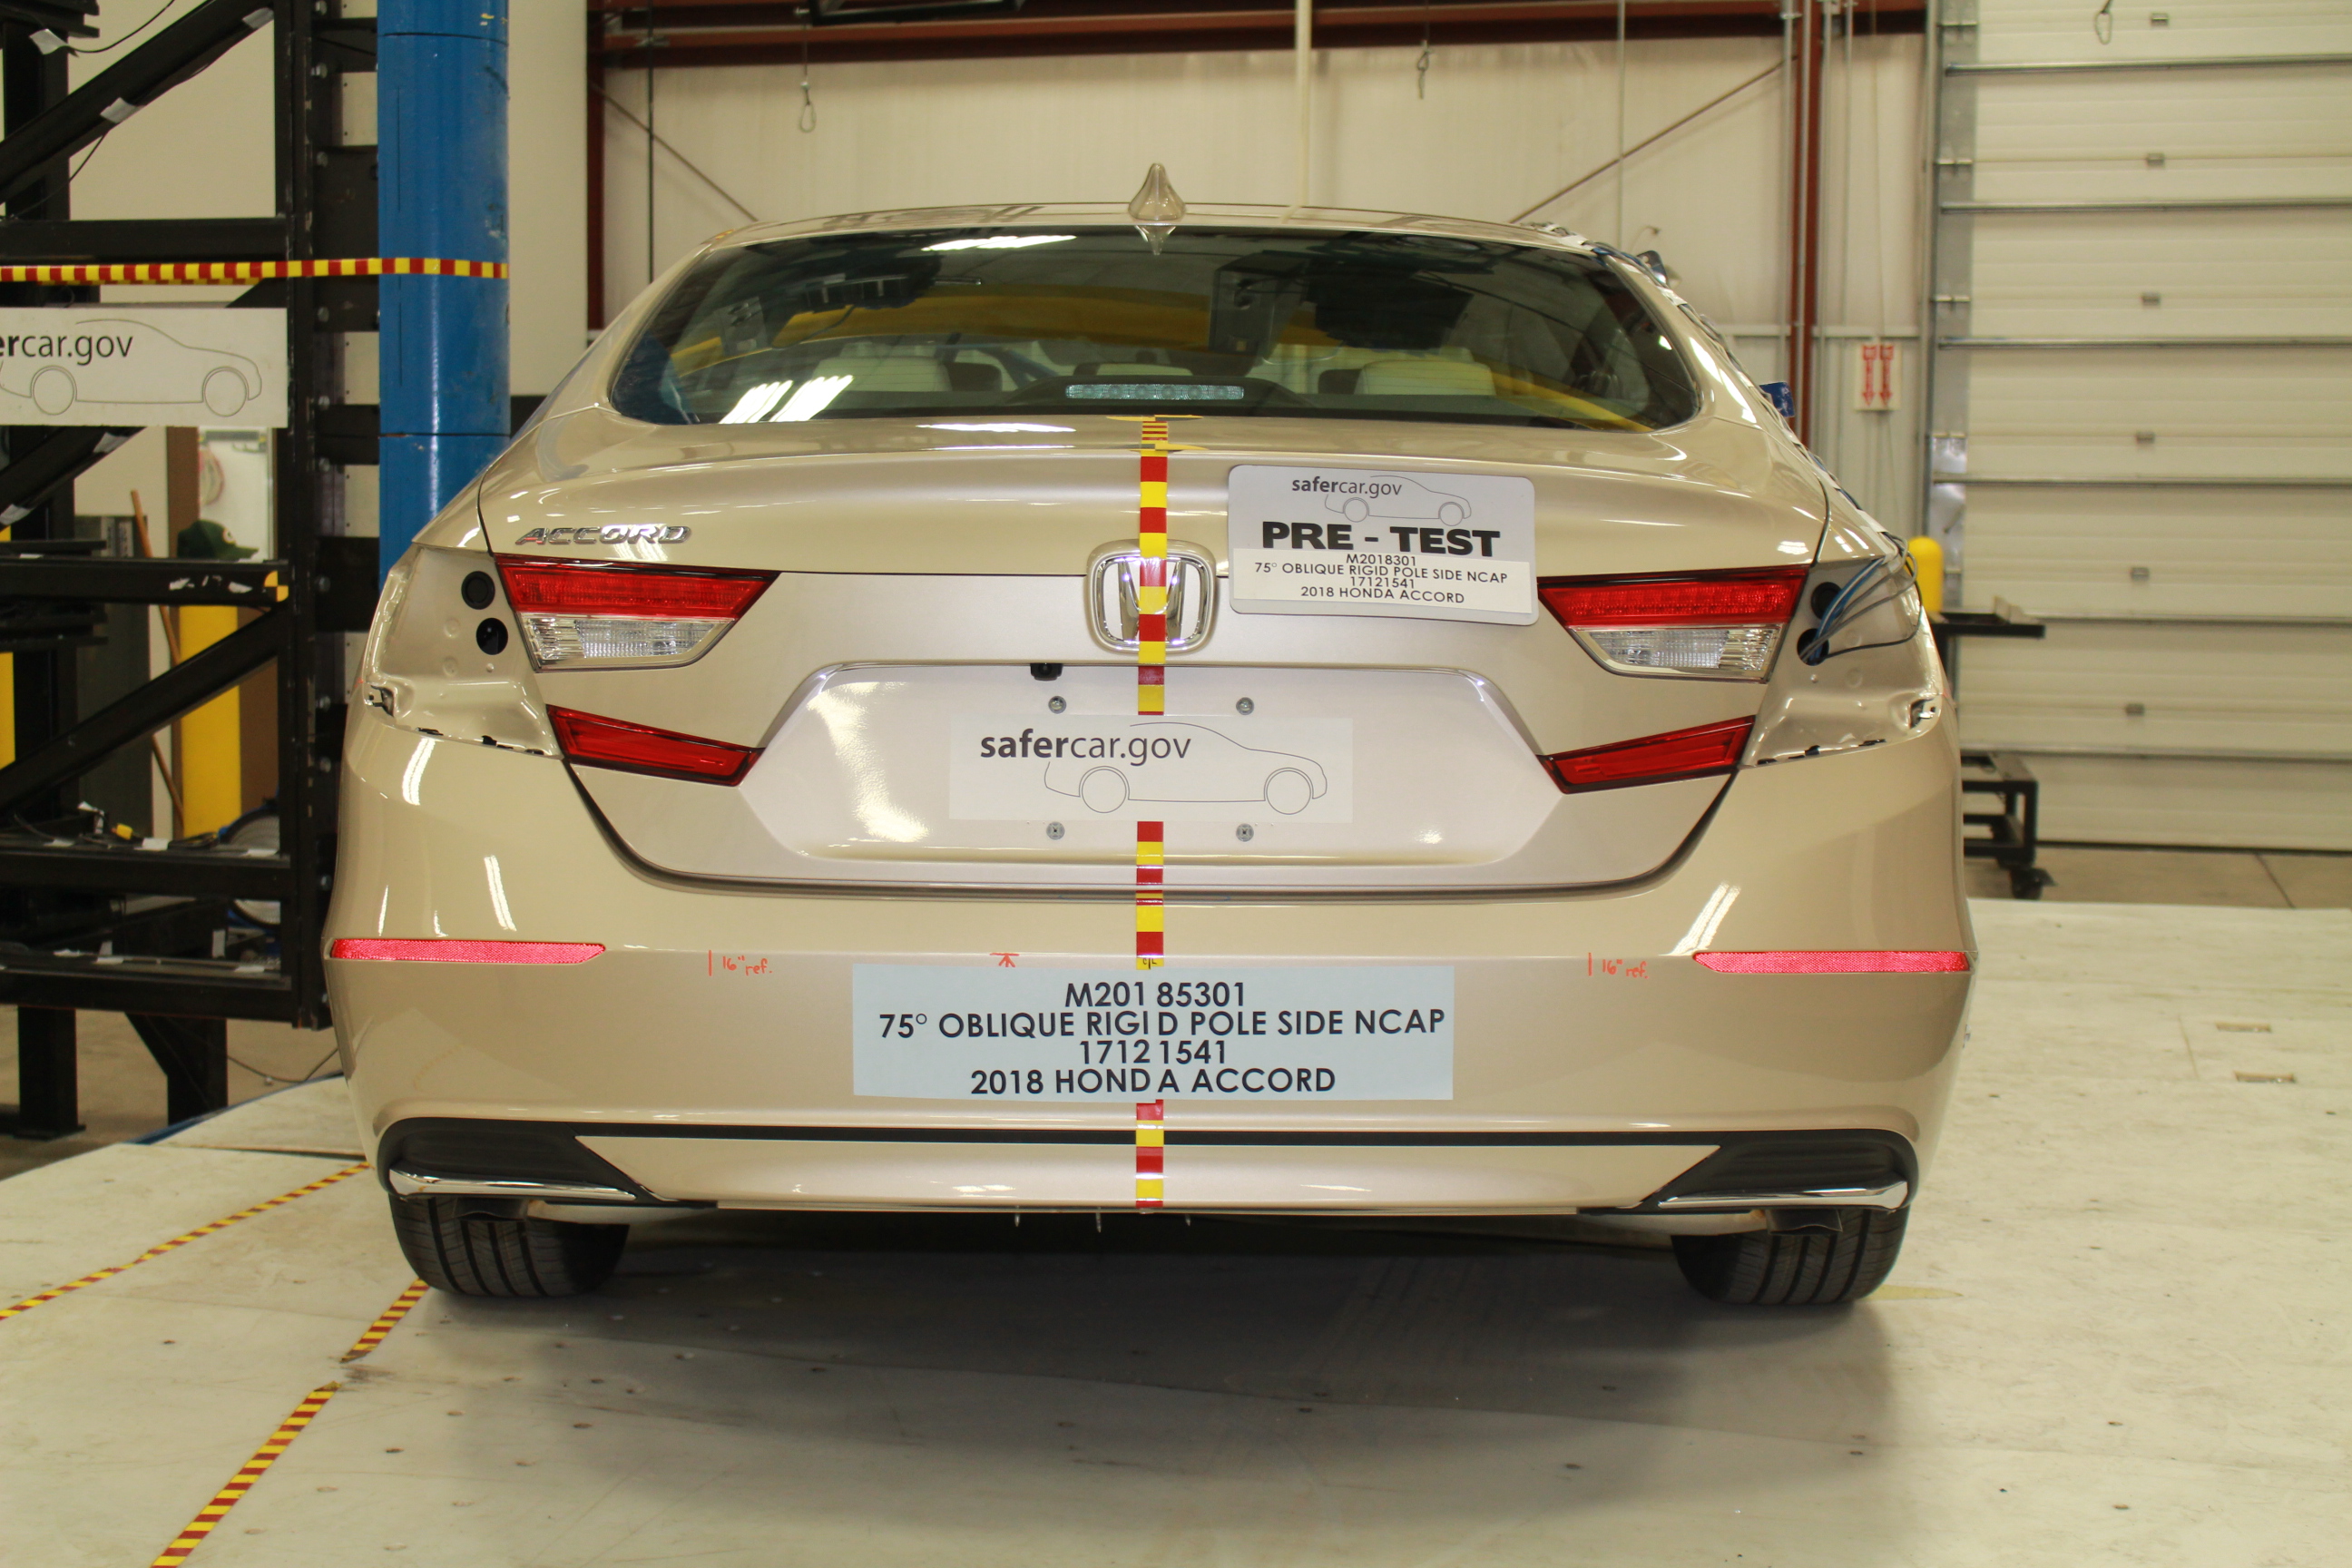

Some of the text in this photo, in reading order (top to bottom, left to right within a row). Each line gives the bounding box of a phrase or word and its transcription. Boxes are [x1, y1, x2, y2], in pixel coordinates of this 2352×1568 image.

[1291, 475, 1402, 499] safercar.gov
[514, 524, 691, 545] ACCORD
[1262, 521, 1354, 550] PRE
[1389, 525, 1501, 557] TEST
[1346, 554, 1416, 566] M2018301
[1254, 562, 1508, 583] 75° OBLIQUE RIGID POLE SIDE NCAP
[1350, 576, 1415, 589] 17121541
[1300, 586, 1465, 603] 2018 HONDA ACCORD
[980, 728, 1191, 767] safercar.gov
[879, 1013, 927, 1039] 75°
[938, 1012, 1074, 1039] OBLIQUE
[1191, 1011, 1267, 1036] POLE
[1278, 1010, 1343, 1035] SIDE
[1356, 1009, 1445, 1034] NCAP
[971, 1069, 1044, 1095] 2018
[1191, 1067, 1336, 1093] ACCORD
